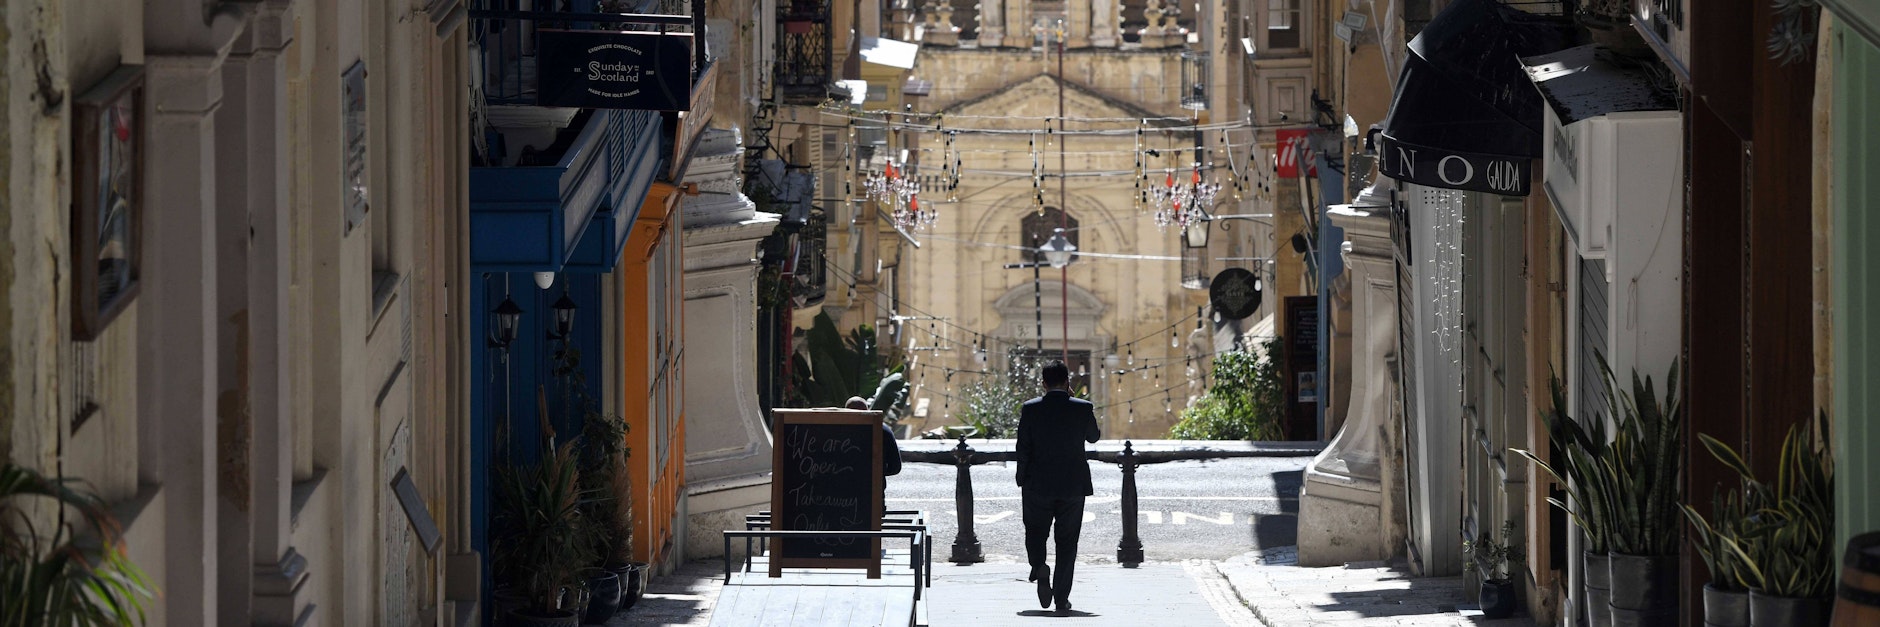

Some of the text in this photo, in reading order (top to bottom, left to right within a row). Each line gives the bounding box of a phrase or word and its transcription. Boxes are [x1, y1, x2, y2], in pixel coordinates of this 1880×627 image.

[588, 44, 642, 55] EXQUISITE CHOCOLATE
[588, 61, 633, 76] Sunday
[787, 425, 860, 459] We are
[800, 456, 853, 479] Open
[789, 482, 861, 525] Takeaway
